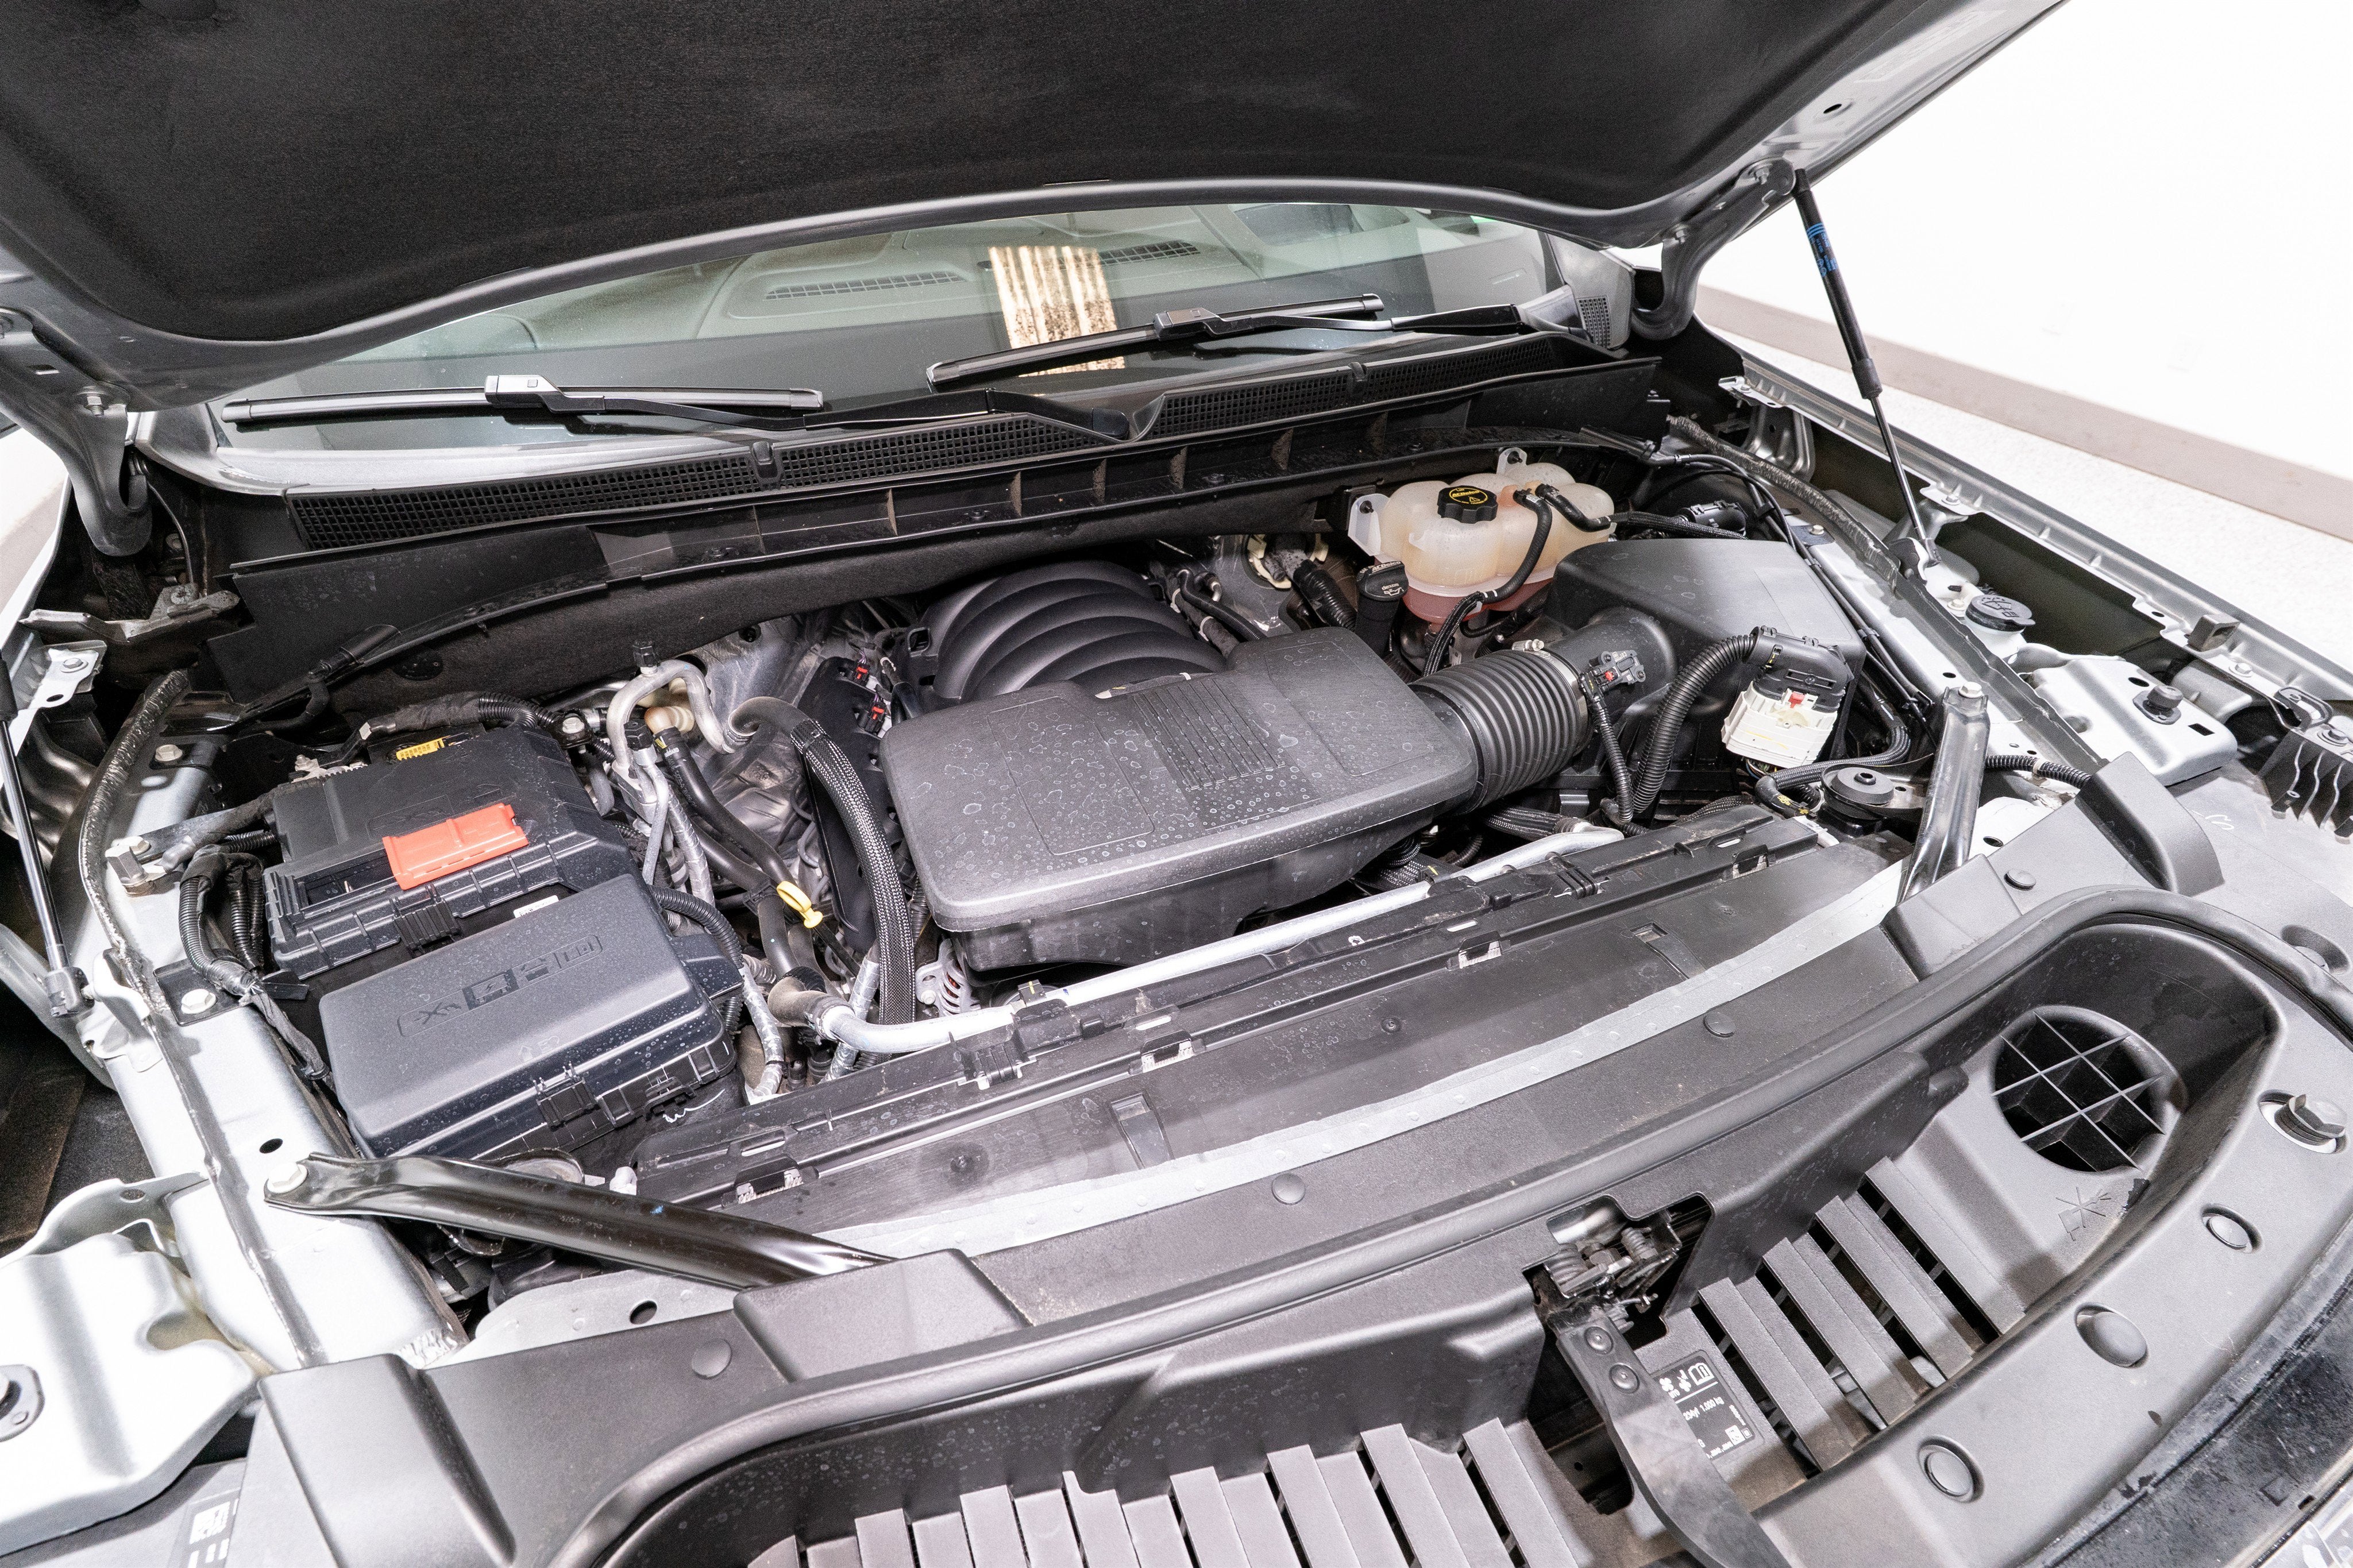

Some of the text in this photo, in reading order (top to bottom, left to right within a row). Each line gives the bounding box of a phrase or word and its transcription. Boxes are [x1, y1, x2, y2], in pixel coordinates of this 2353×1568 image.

[1452, 490, 1480, 498] ACDelco
[1372, 561, 1401, 572] ACDelco
[1699, 1399, 1716, 1412] 1.000
[1713, 1396, 1725, 1405] kg
